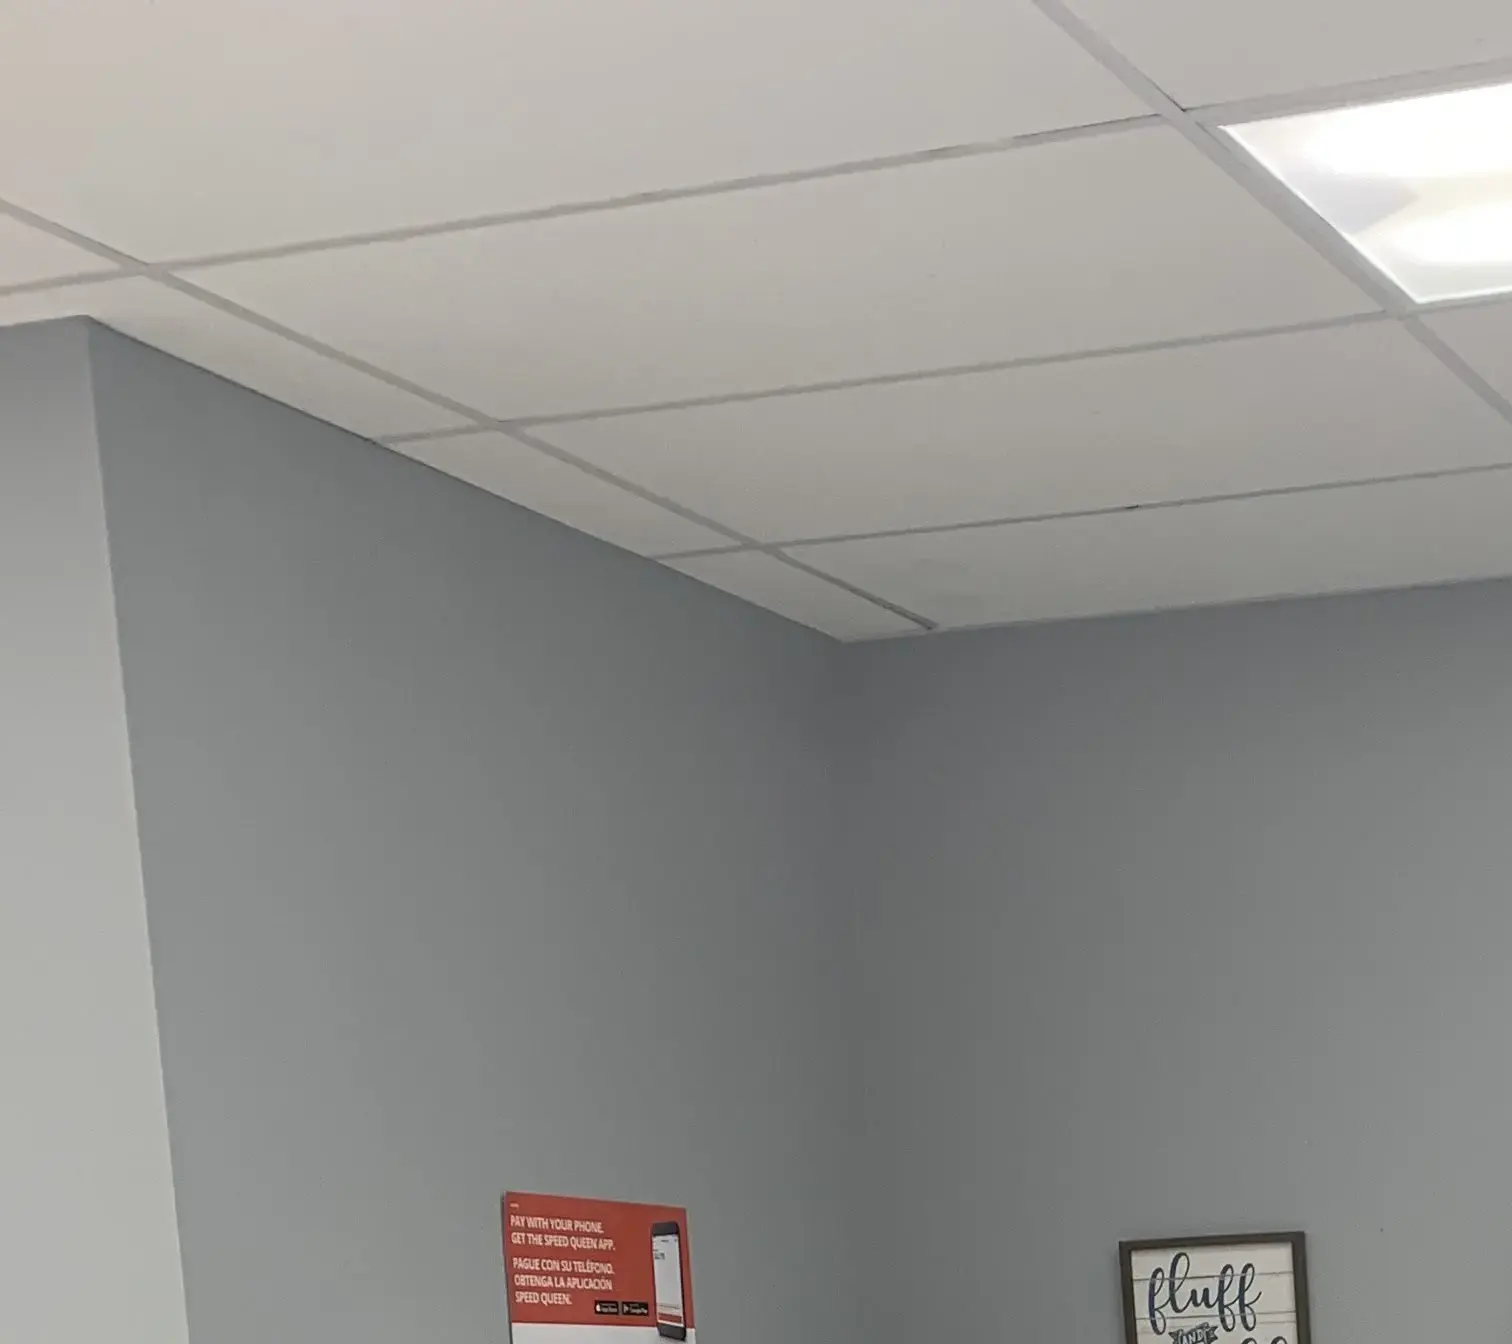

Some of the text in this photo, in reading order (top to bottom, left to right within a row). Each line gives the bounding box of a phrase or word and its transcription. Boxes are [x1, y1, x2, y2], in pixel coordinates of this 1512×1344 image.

[510, 1215, 527, 1228] PAY
[527, 1217, 549, 1230] WITH
[549, 1219, 573, 1231] YOUR
[511, 1232, 616, 1251] GET THE SPEED QUEEN APP.
[513, 1257, 540, 1270] PAGUE
[541, 1259, 560, 1272] CON
[561, 1261, 572, 1273] SU
[514, 1274, 553, 1288] OBTENGA
[554, 1277, 566, 1289] LA
[515, 1291, 540, 1304] SPEED
[1148, 1252, 1262, 1335] fluff
